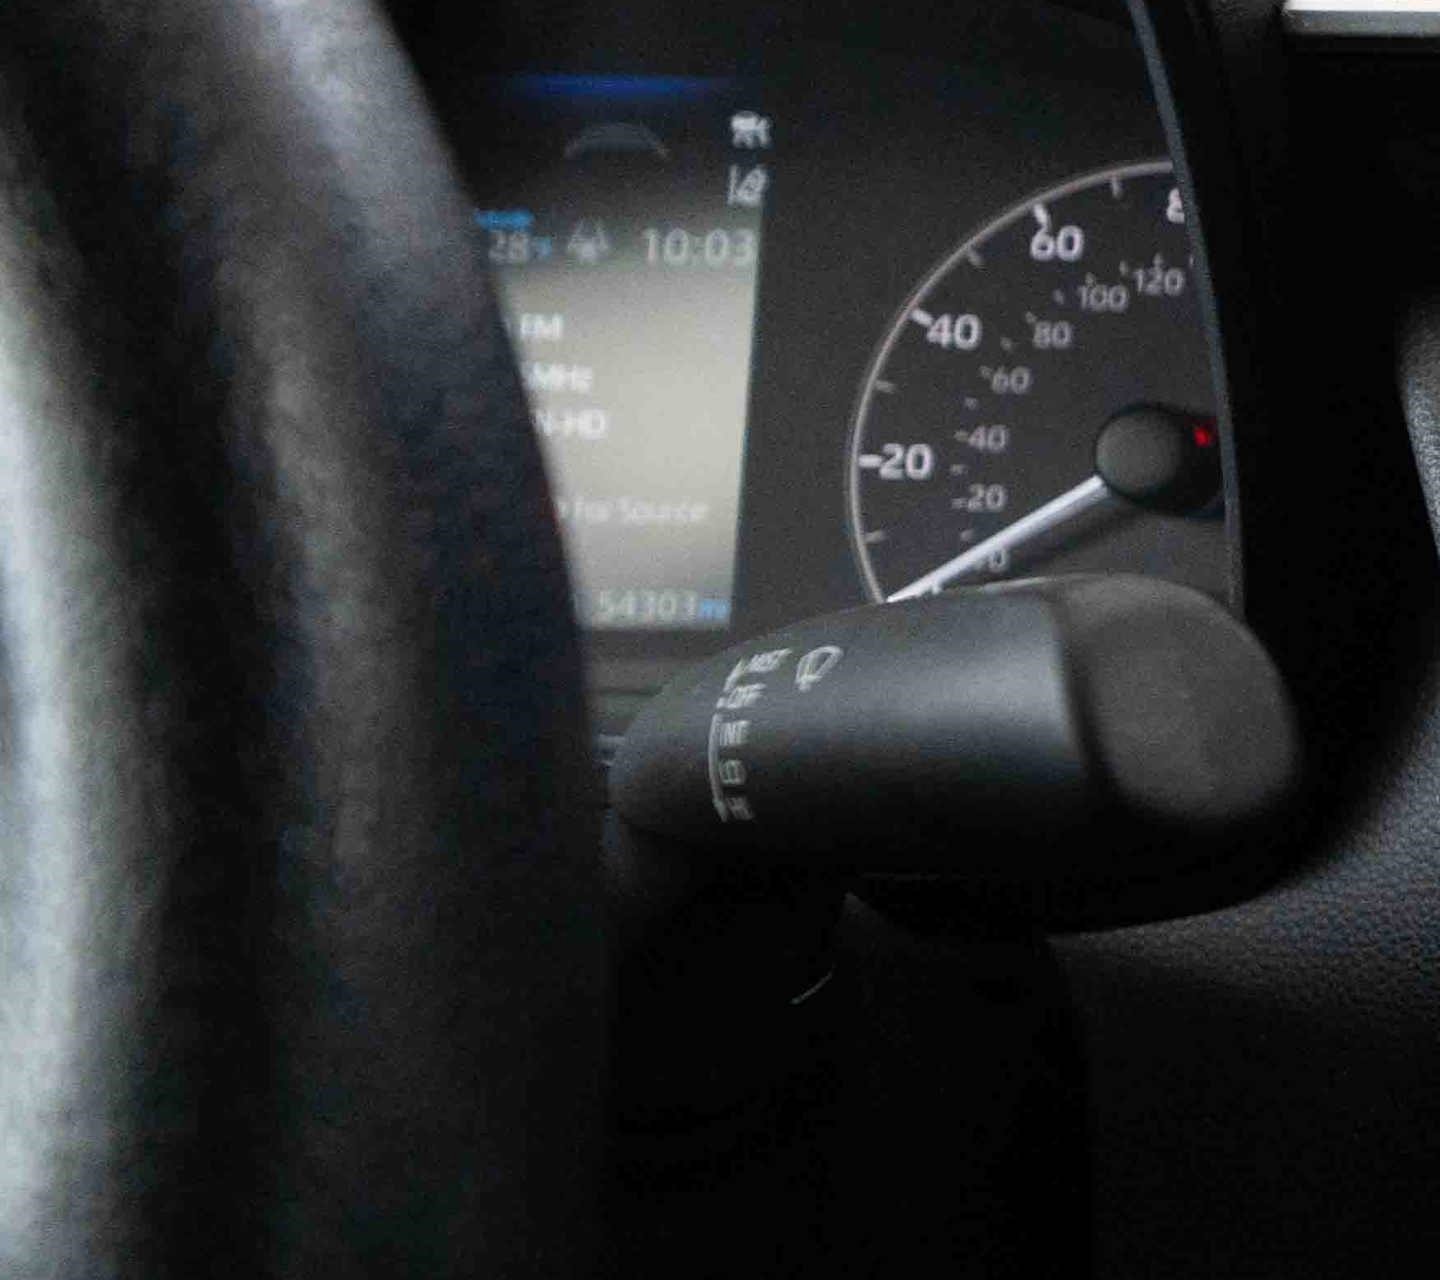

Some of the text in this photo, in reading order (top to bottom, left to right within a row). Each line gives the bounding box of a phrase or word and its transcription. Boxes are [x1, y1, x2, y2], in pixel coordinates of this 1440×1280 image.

[643, 228, 757, 267] 10:03
[1029, 225, 1084, 263] 60
[1134, 267, 1185, 297] 120
[1078, 283, 1129, 313] 100
[927, 313, 982, 350] 40
[1033, 320, 1073, 349] 80
[991, 367, 1032, 395] 60
[968, 425, 1009, 453] 40
[879, 443, 934, 481] 20
[967, 483, 1008, 513] 20
